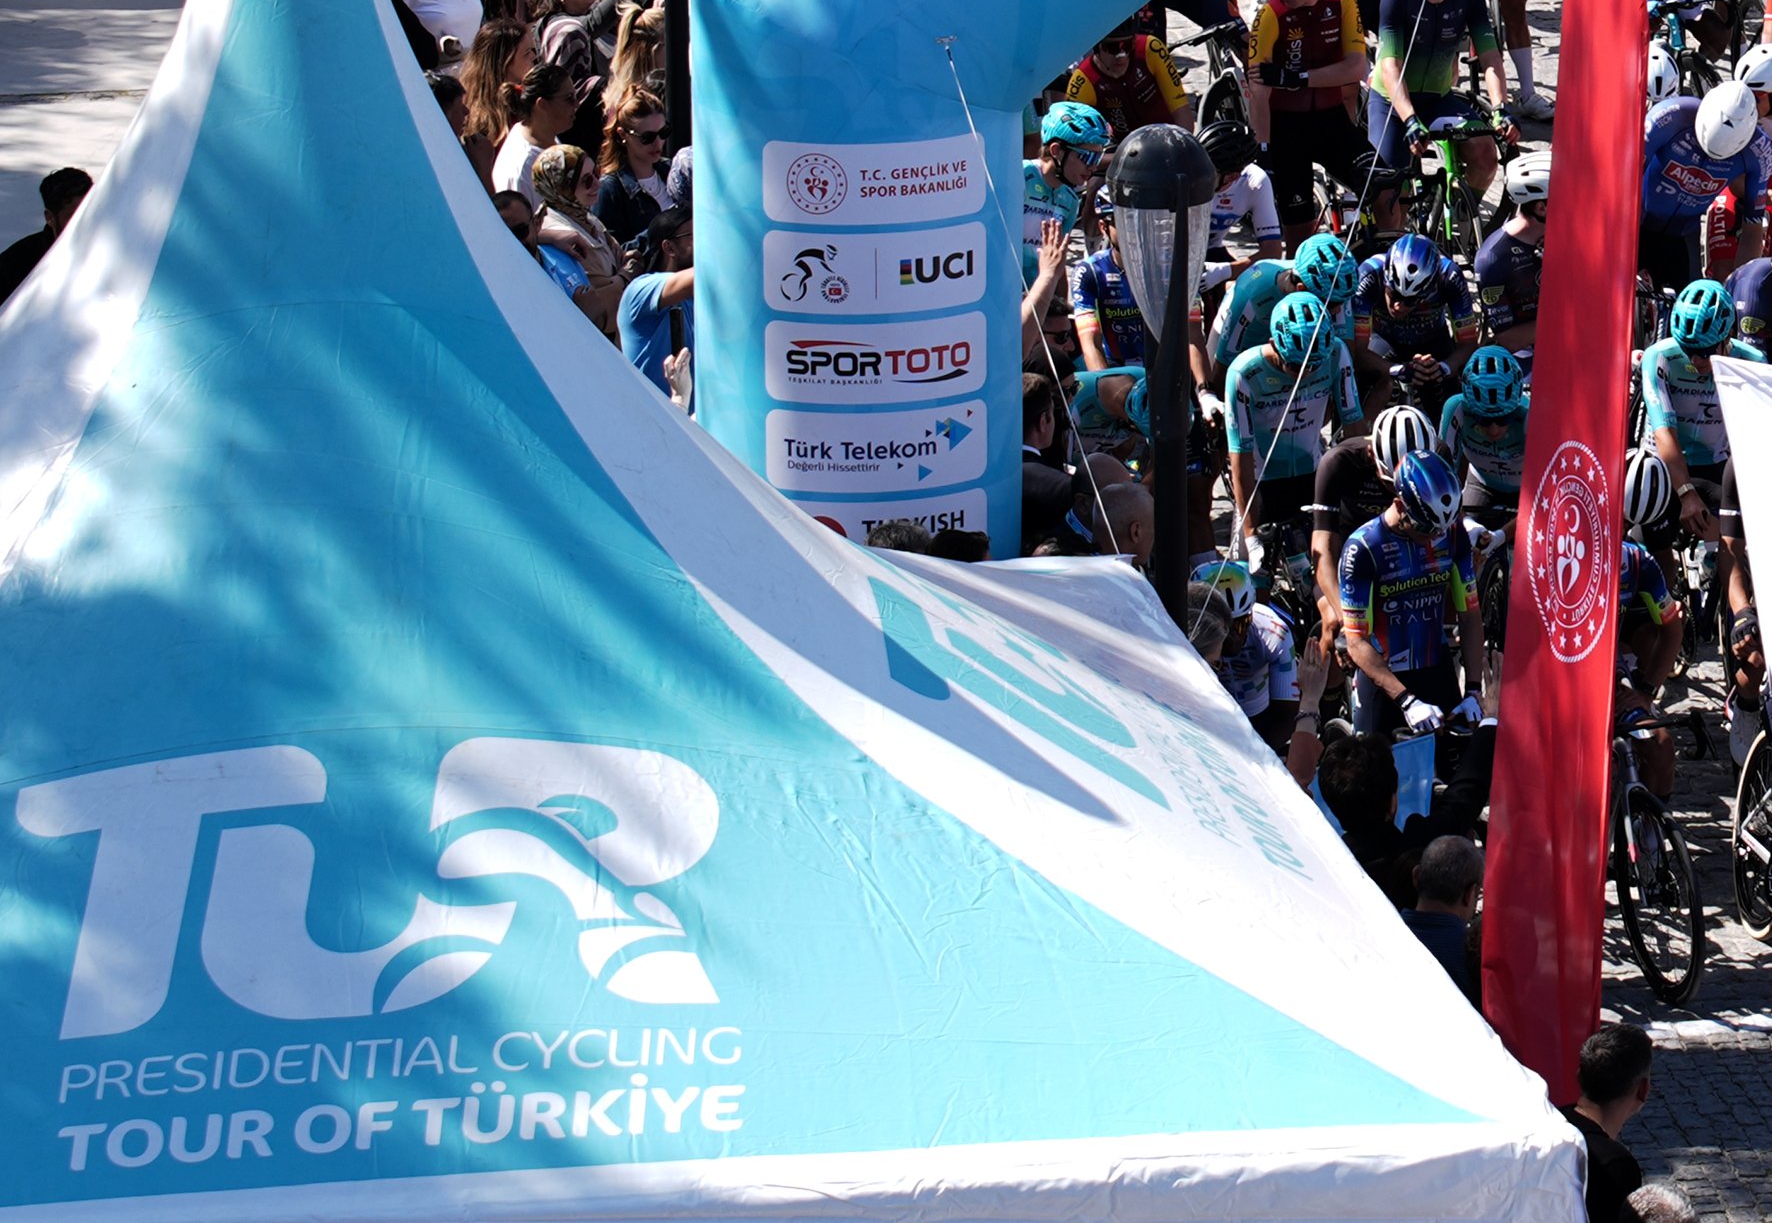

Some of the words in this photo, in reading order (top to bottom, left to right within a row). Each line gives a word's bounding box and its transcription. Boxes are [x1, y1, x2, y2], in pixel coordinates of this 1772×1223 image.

[1149, 38, 1183, 88] Cofidis
[860, 169, 887, 181] T.C.
[891, 161, 949, 180] GENÇLİK
[951, 160, 967, 172] VE
[1669, 167, 1721, 192] Alpecin
[860, 185, 897, 198] SPOR
[900, 176, 967, 196] BAKANLIĞI
[915, 249, 973, 283] UCI
[784, 438, 833, 460] Türk
[841, 440, 937, 460] Telekom
[787, 459, 825, 472] Değerli
[827, 461, 881, 473] Hissettirir
[1378, 576, 1429, 598] Solution
[1429, 570, 1452, 586] Tech
[1403, 593, 1443, 611] NIPPO
[15, 735, 721, 1041] TUR
[59, 1035, 460, 1105] PRESIDENTIAL
[492, 1025, 743, 1076] CYCLING
[58, 1111, 276, 1171] TOUR
[293, 1100, 399, 1153] OF
[411, 1073, 746, 1148] TÜRKİYE
